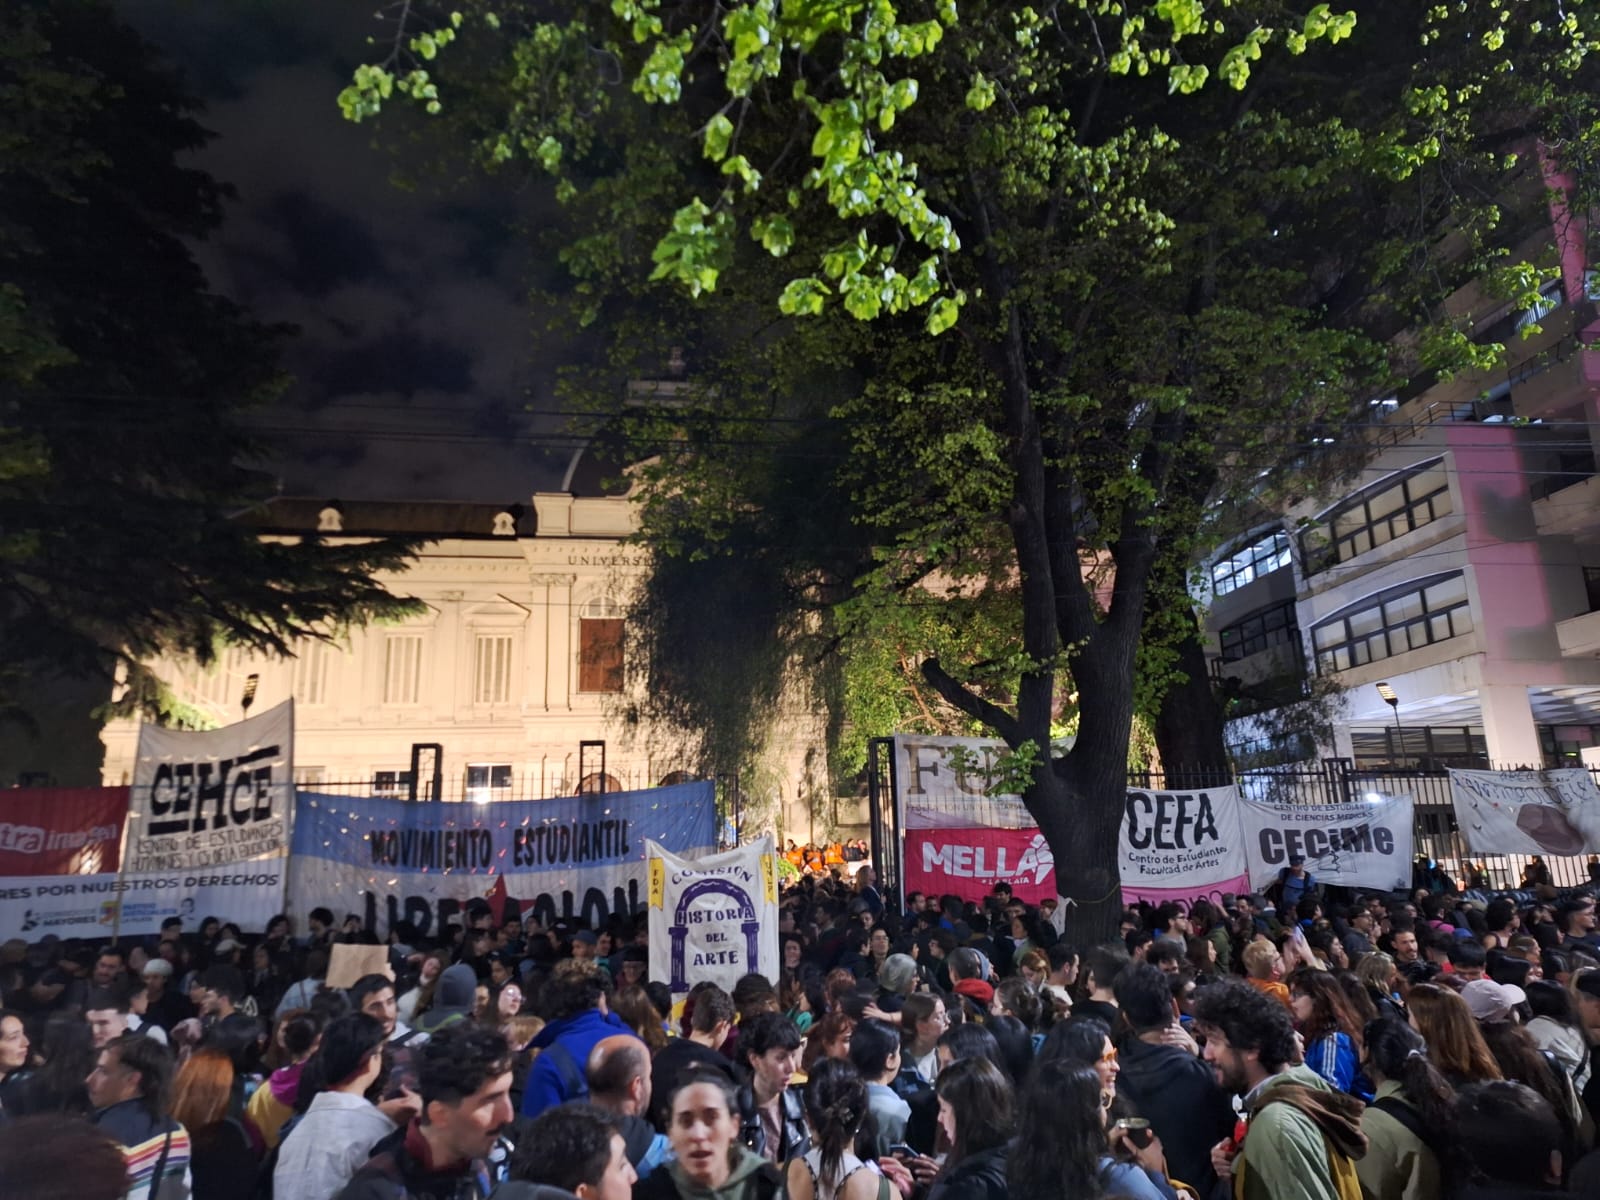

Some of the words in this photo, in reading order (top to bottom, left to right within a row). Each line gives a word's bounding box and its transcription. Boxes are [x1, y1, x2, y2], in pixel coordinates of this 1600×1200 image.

[1274, 804, 1310, 812] CENTRO
[1126, 792, 1219, 850] CEFA
[1280, 813, 1293, 821] DE
[1295, 813, 1335, 822] CIENCIAS
[186, 834, 202, 850] DE
[369, 828, 493, 869] MOVIMIENTO
[513, 819, 630, 868] ESTUDIANTIL
[922, 841, 1039, 878] MELLA
[1128, 852, 1161, 864] Centro
[1162, 855, 1175, 864] de
[1140, 864, 1181, 875] Facultad
[1183, 863, 1194, 872] de
[1194, 858, 1220, 870] Artes
[37, 884, 76, 897] POR
[81, 877, 179, 894] NUESTROS
[184, 874, 280, 888] DERECHOS
[678, 907, 754, 925] HISTORIA
[705, 932, 727, 943] DEL
[692, 950, 739, 966] ARTE
